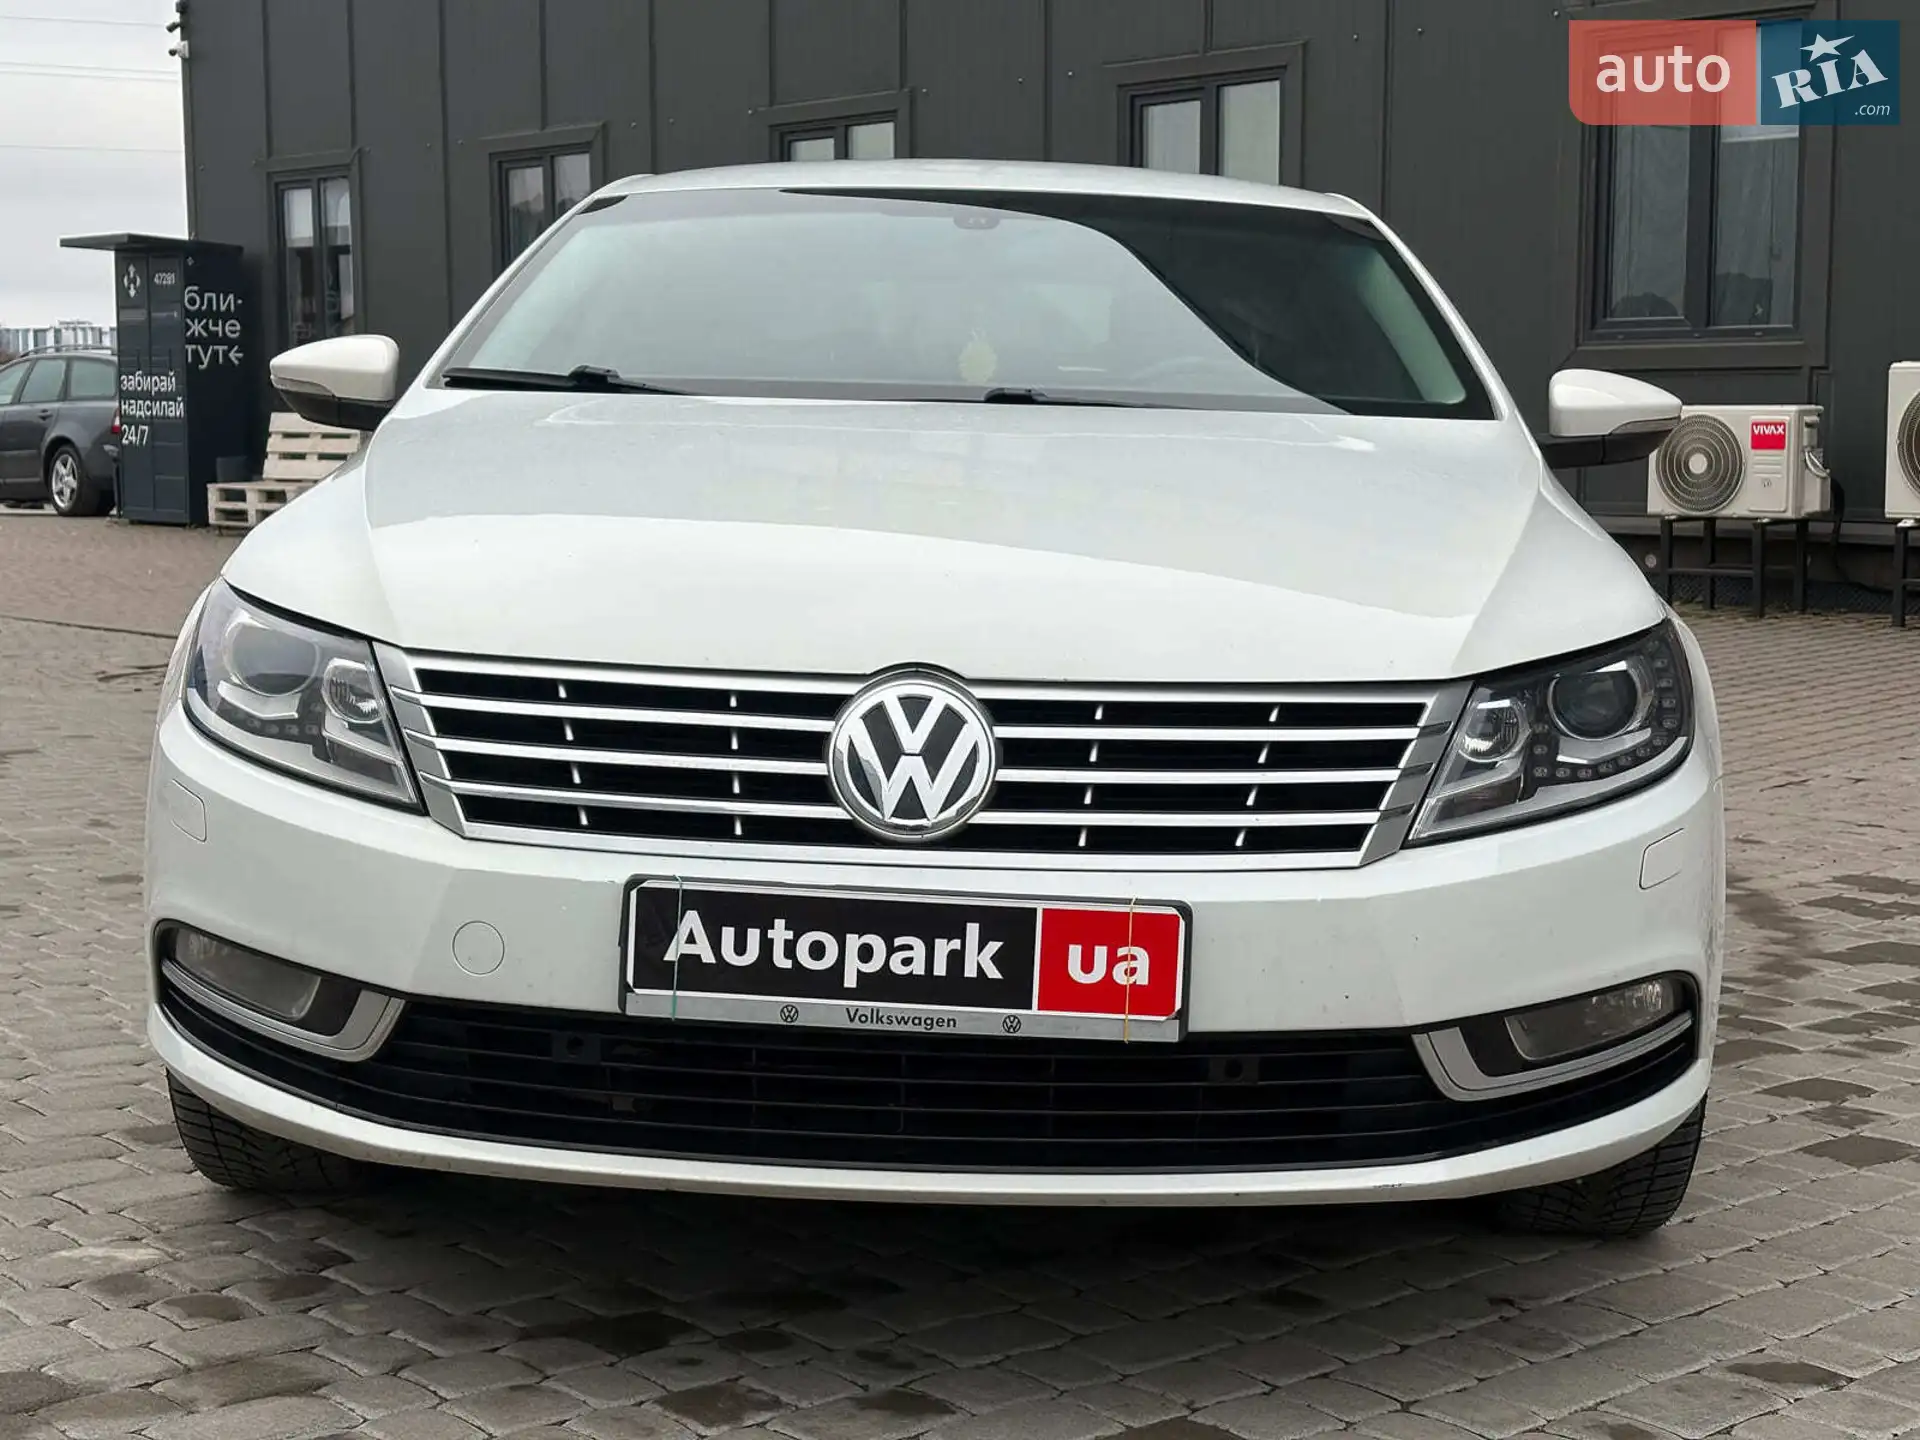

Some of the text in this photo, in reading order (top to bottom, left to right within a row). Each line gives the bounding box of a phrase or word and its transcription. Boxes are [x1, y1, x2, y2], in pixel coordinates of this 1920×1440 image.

[185, 318, 241, 338] жче
[185, 344, 228, 370] тут
[120, 370, 176, 396] забирай
[120, 396, 185, 420] надсилай
[121, 424, 149, 446] 24/7
[1752, 424, 1785, 435] VIVAX
[662, 909, 1150, 989] Autopark ua
[845, 1007, 957, 1031] Volkswagen
